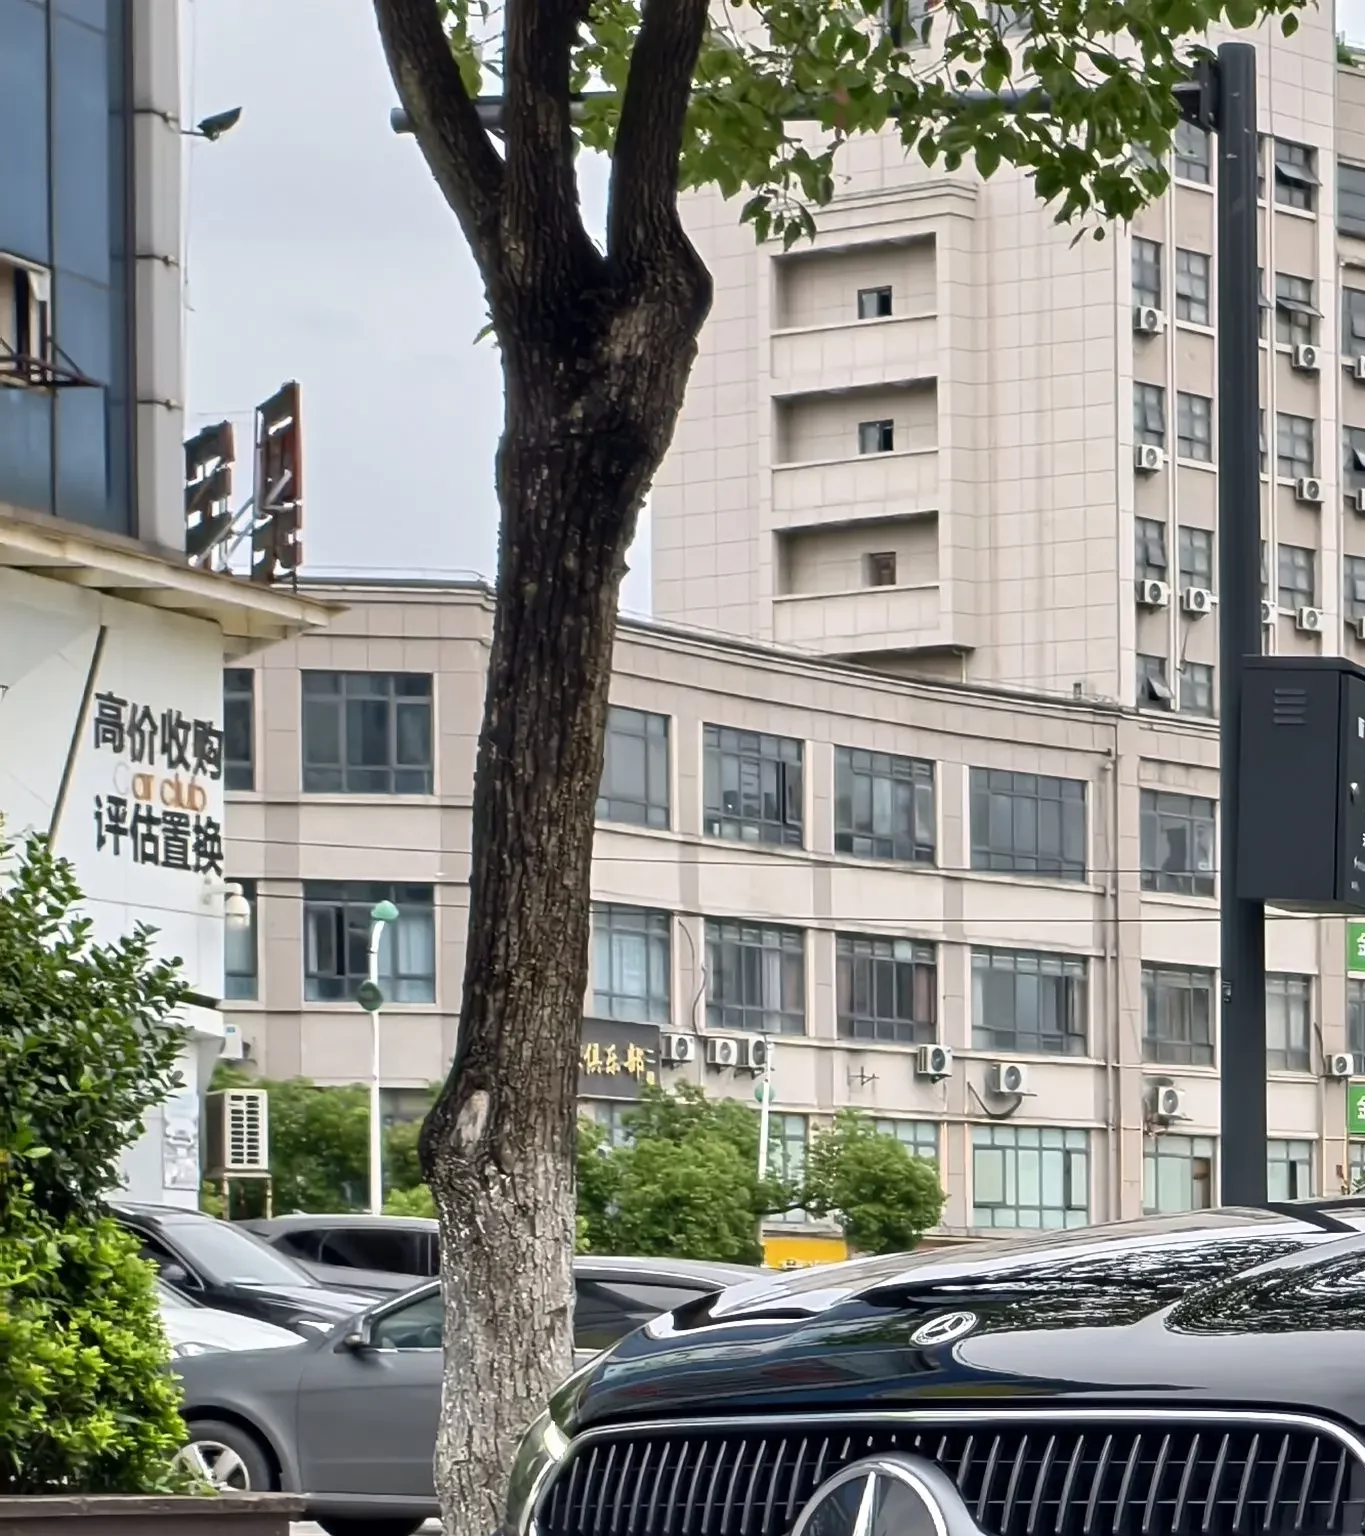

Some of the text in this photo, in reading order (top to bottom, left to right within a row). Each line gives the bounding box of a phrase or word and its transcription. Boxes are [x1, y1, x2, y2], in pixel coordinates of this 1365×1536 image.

[94, 691, 224, 780] 高价收购
[94, 794, 224, 876] 评估置换
[578, 1042, 644, 1080] 俱乐部
